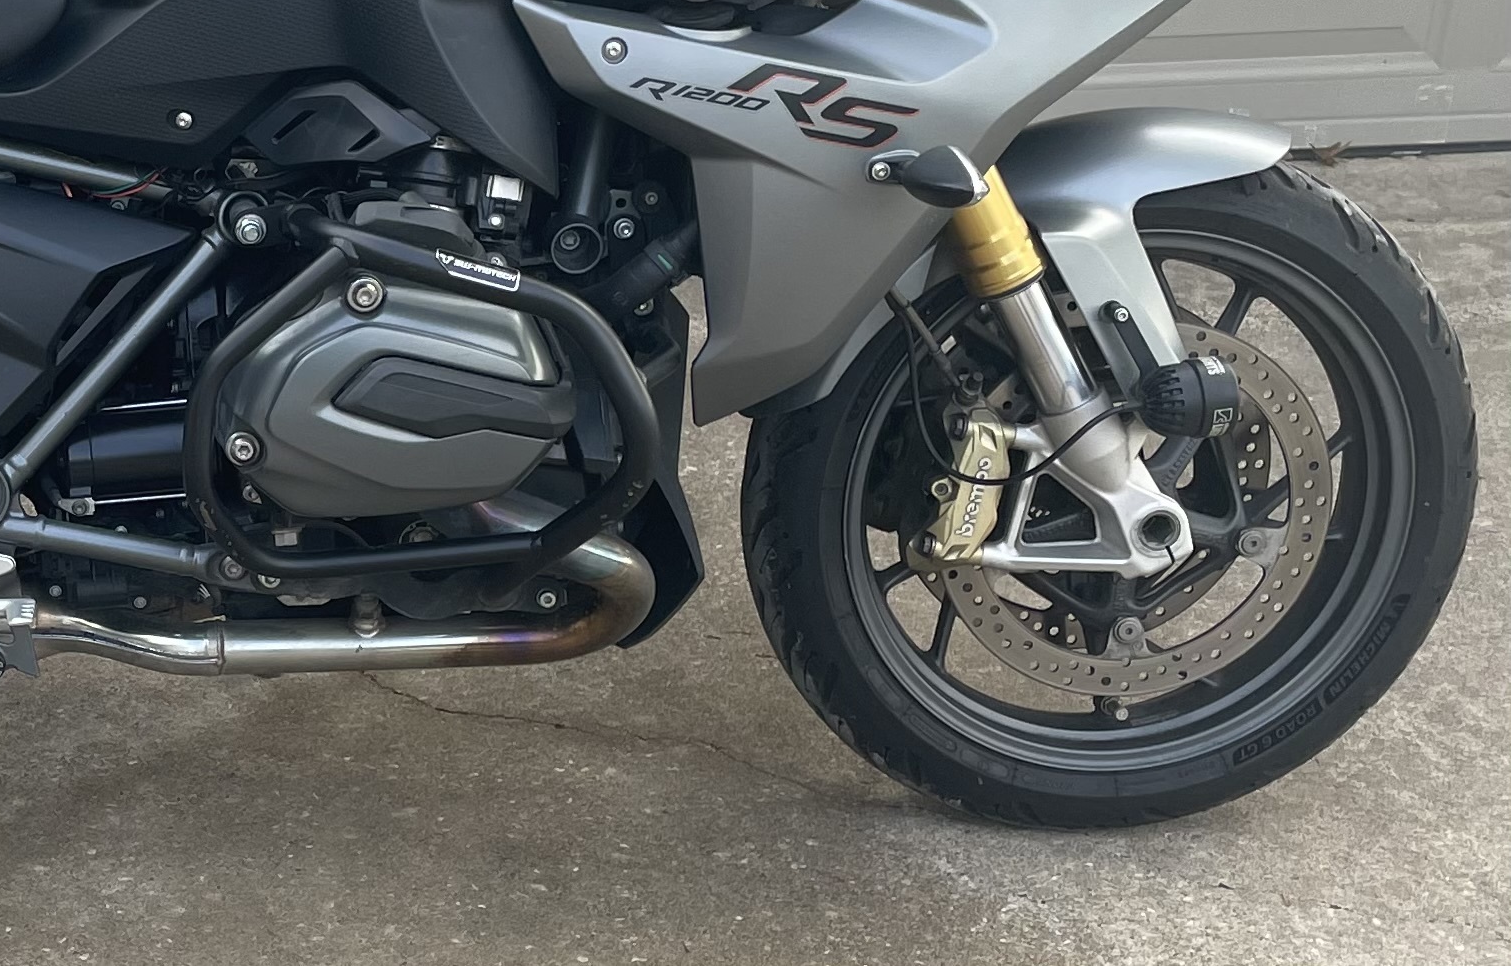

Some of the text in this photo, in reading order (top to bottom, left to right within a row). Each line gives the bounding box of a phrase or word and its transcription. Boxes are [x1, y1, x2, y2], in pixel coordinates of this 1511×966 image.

[629, 63, 921, 149] R1200 RS
[1328, 619, 1392, 698] MICHELIN
[1274, 705, 1318, 739] ROAD
